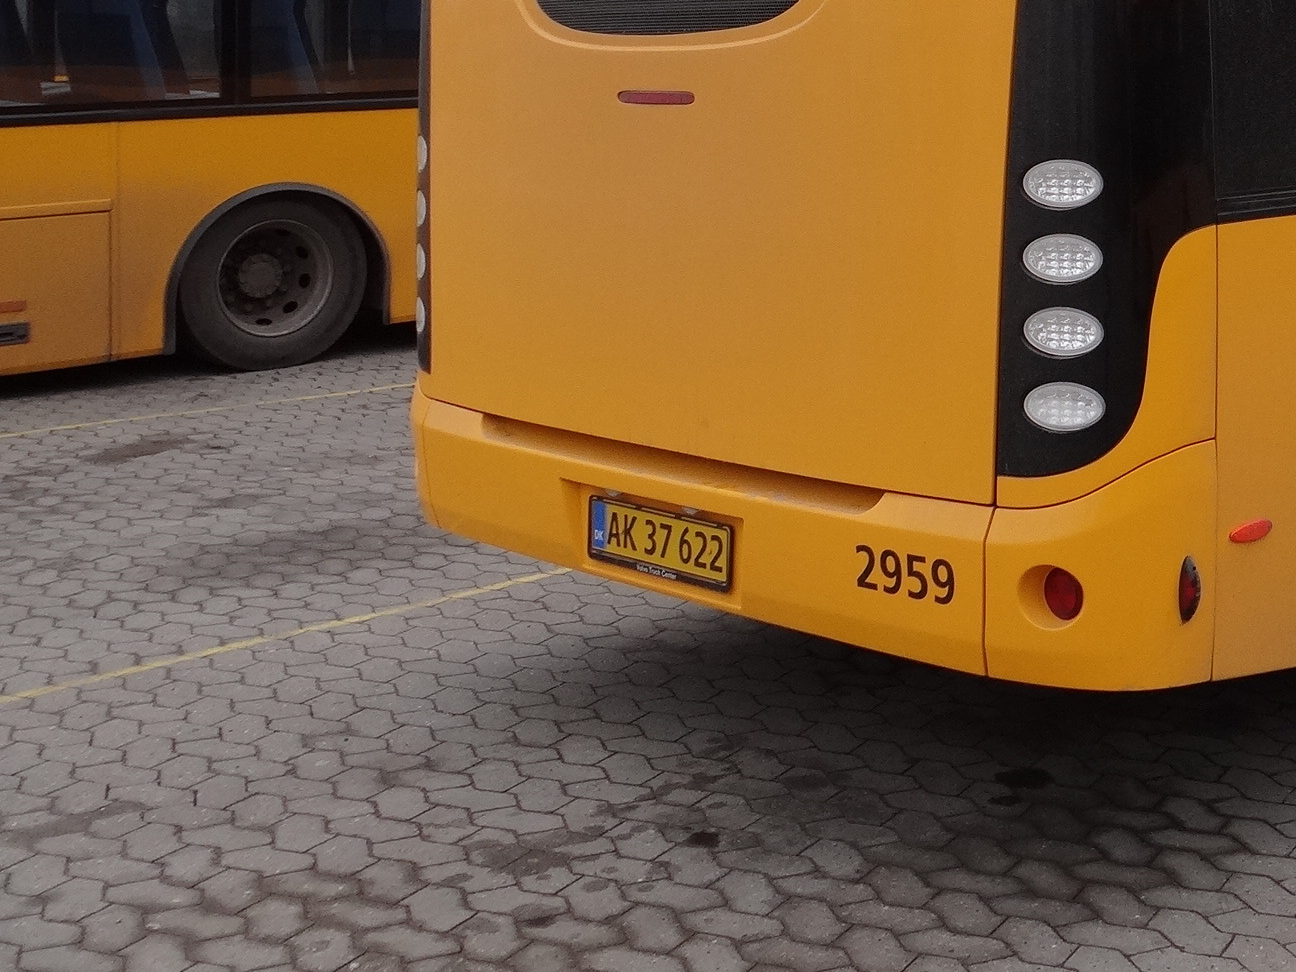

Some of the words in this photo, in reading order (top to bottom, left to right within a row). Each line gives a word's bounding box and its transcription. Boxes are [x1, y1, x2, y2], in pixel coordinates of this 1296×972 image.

[594, 529, 604, 540] DK
[607, 511, 638, 551] AK
[643, 519, 673, 558] 37
[679, 526, 723, 573] 622
[855, 544, 955, 605] 2959
